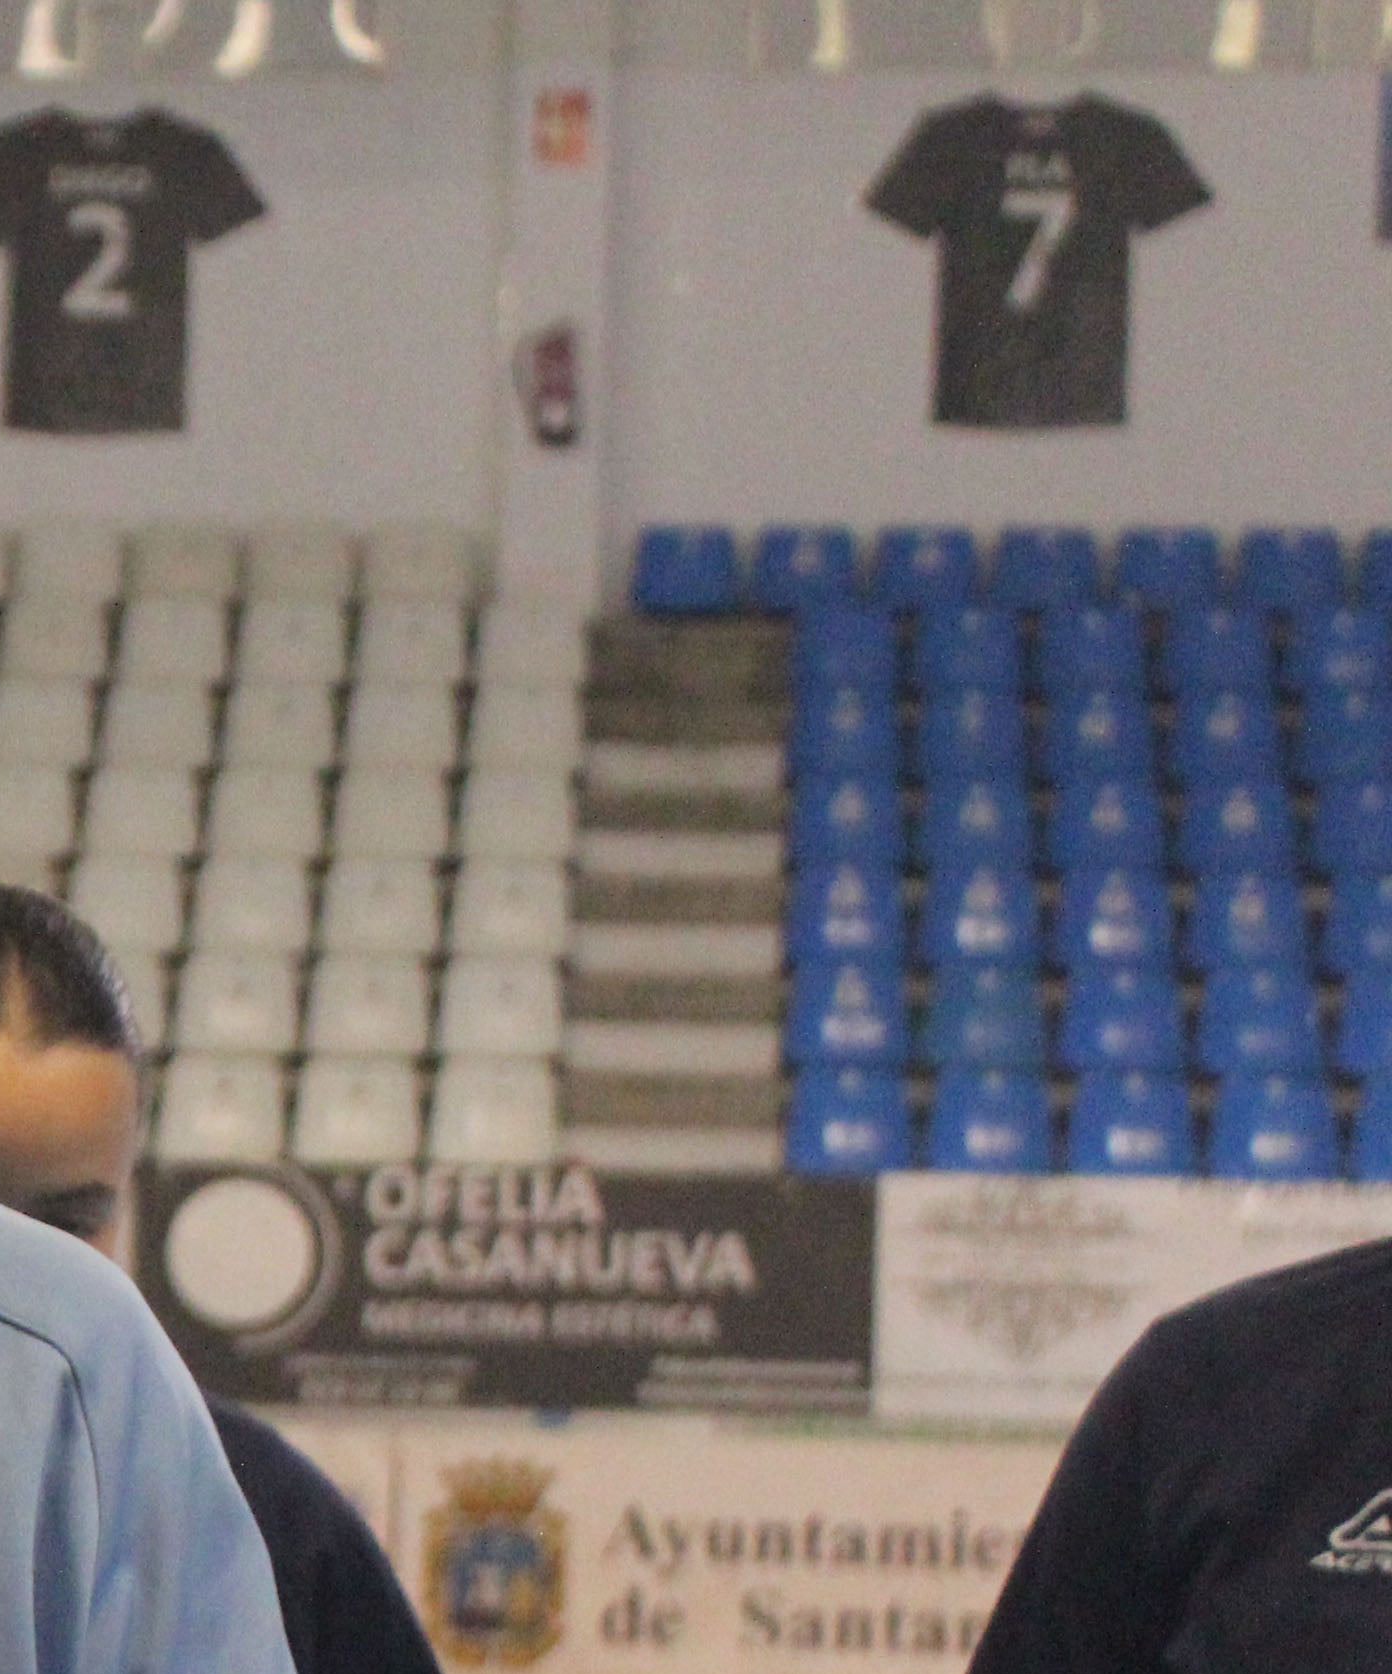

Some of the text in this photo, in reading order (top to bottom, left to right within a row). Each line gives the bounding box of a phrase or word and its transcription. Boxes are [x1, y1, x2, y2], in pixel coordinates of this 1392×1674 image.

[62, 204, 132, 317] 2
[1004, 190, 1077, 309] 7
[367, 1165, 606, 1225] OFELIA
[362, 1229, 757, 1294] CASANUEVA
[603, 1504, 1014, 1576] Ayuntamie
[601, 1595, 683, 1650] de
